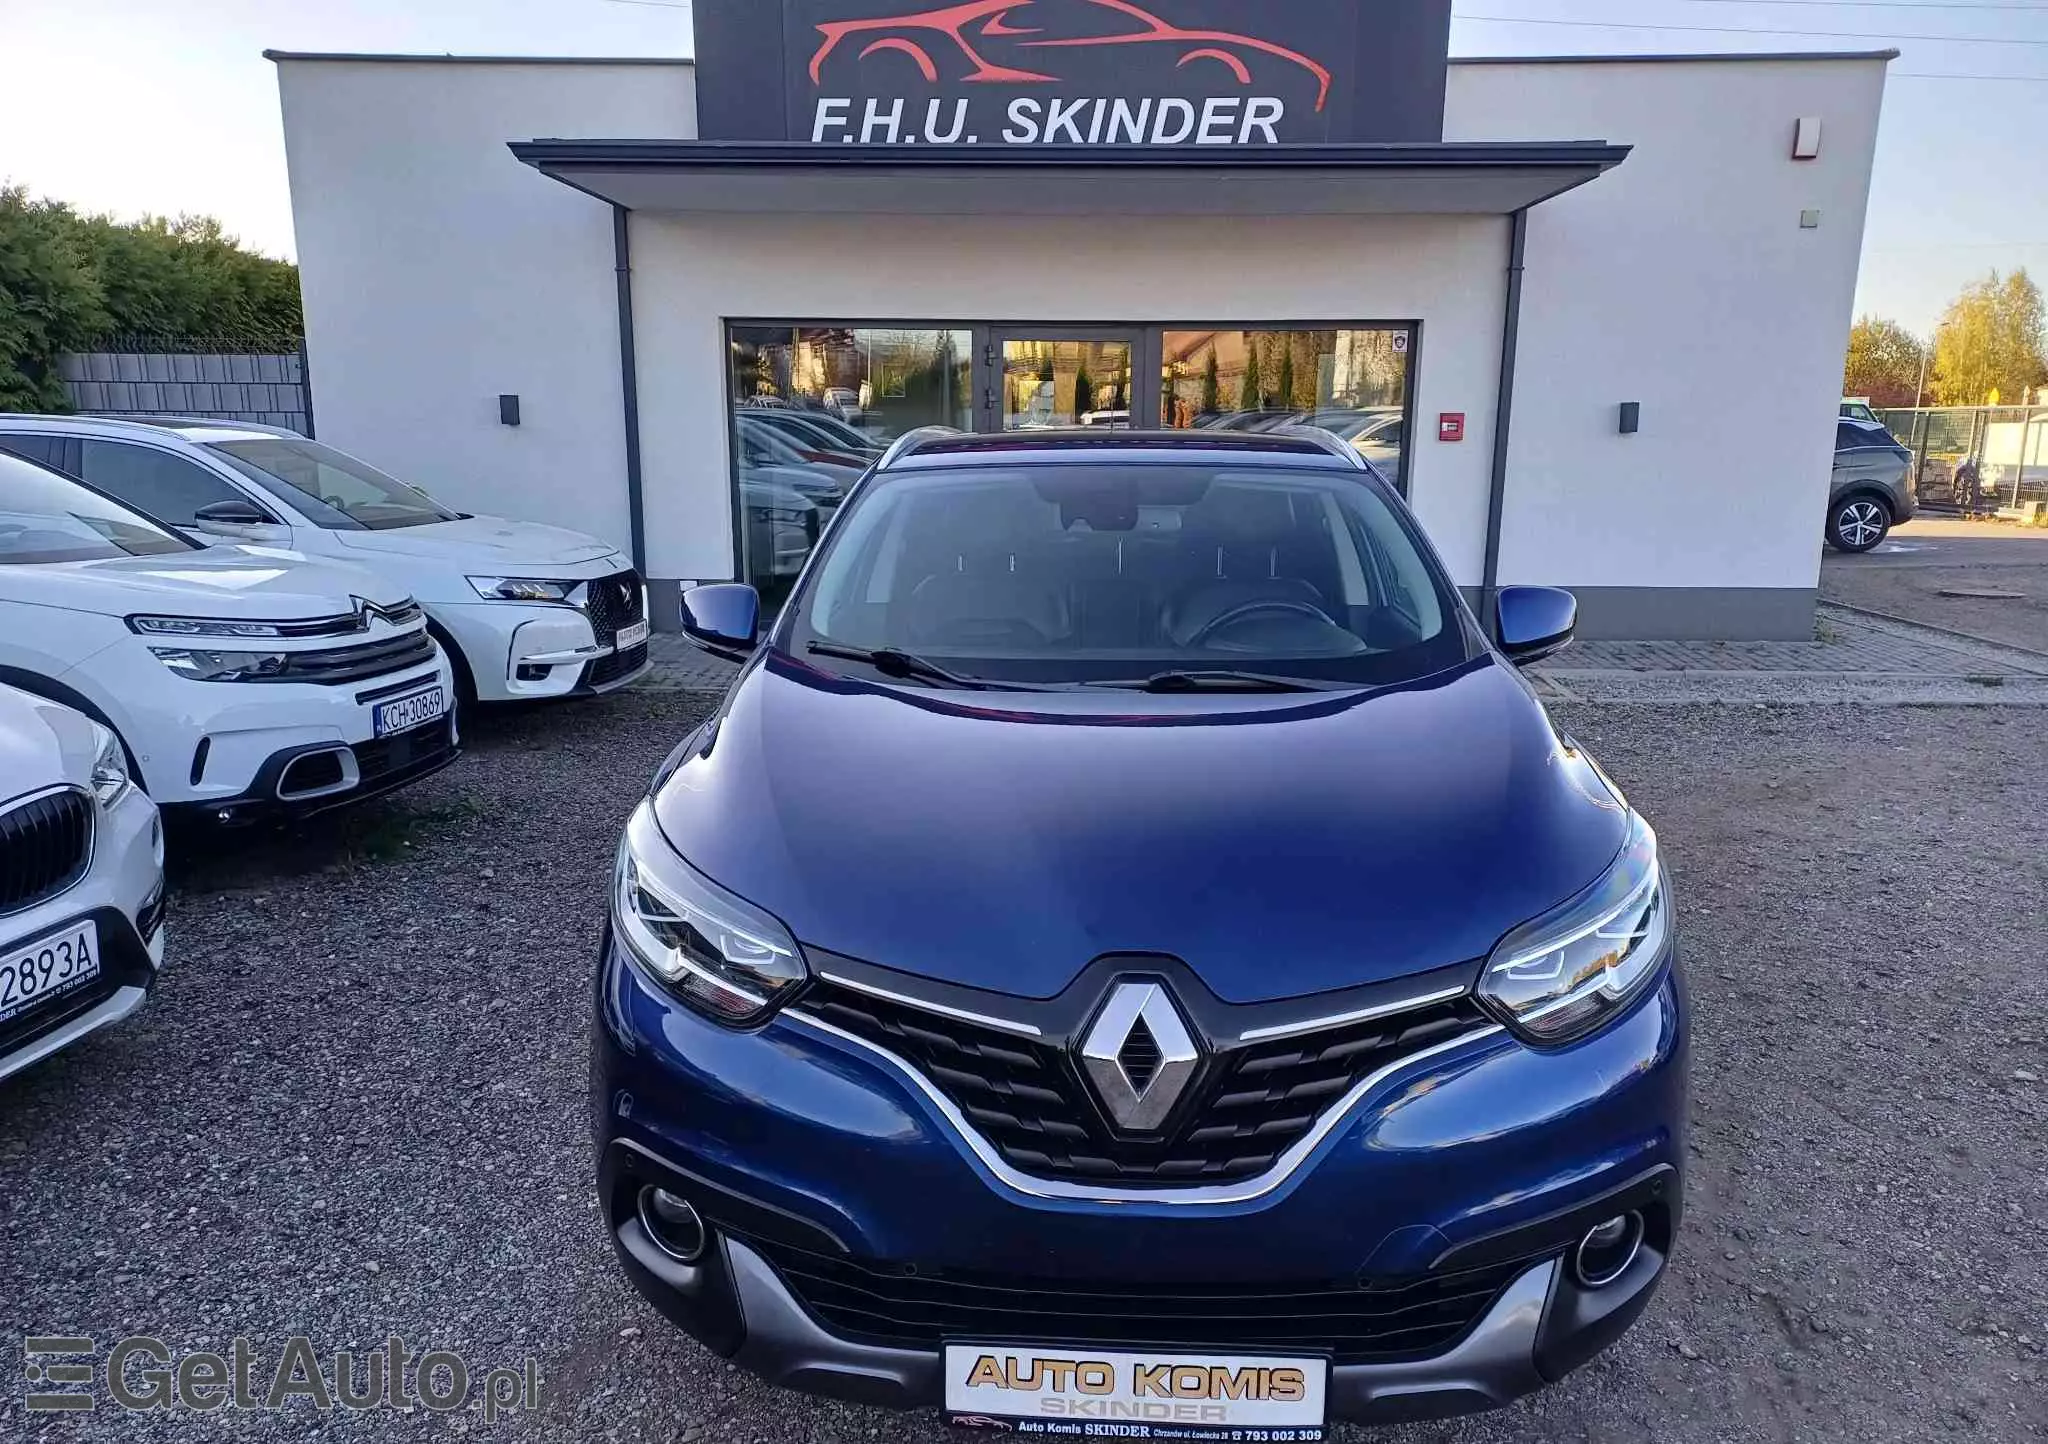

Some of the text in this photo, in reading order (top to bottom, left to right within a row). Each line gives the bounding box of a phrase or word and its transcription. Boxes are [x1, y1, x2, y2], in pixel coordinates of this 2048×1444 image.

[811, 97, 1286, 145] F.H.U. SKINDER
[382, 691, 440, 732] KCH 30869
[966, 1355, 1305, 1402] AUTO KOMIS
[1040, 1397, 1227, 1422] SKINDER
[1018, 1421, 1044, 1432] Auto
[1047, 1423, 1081, 1434] Komis
[1084, 1423, 1151, 1438] SKINDER
[1245, 1430, 1269, 1441] 793
[1272, 1430, 1295, 1441] 002
[1298, 1430, 1322, 1441] 309
